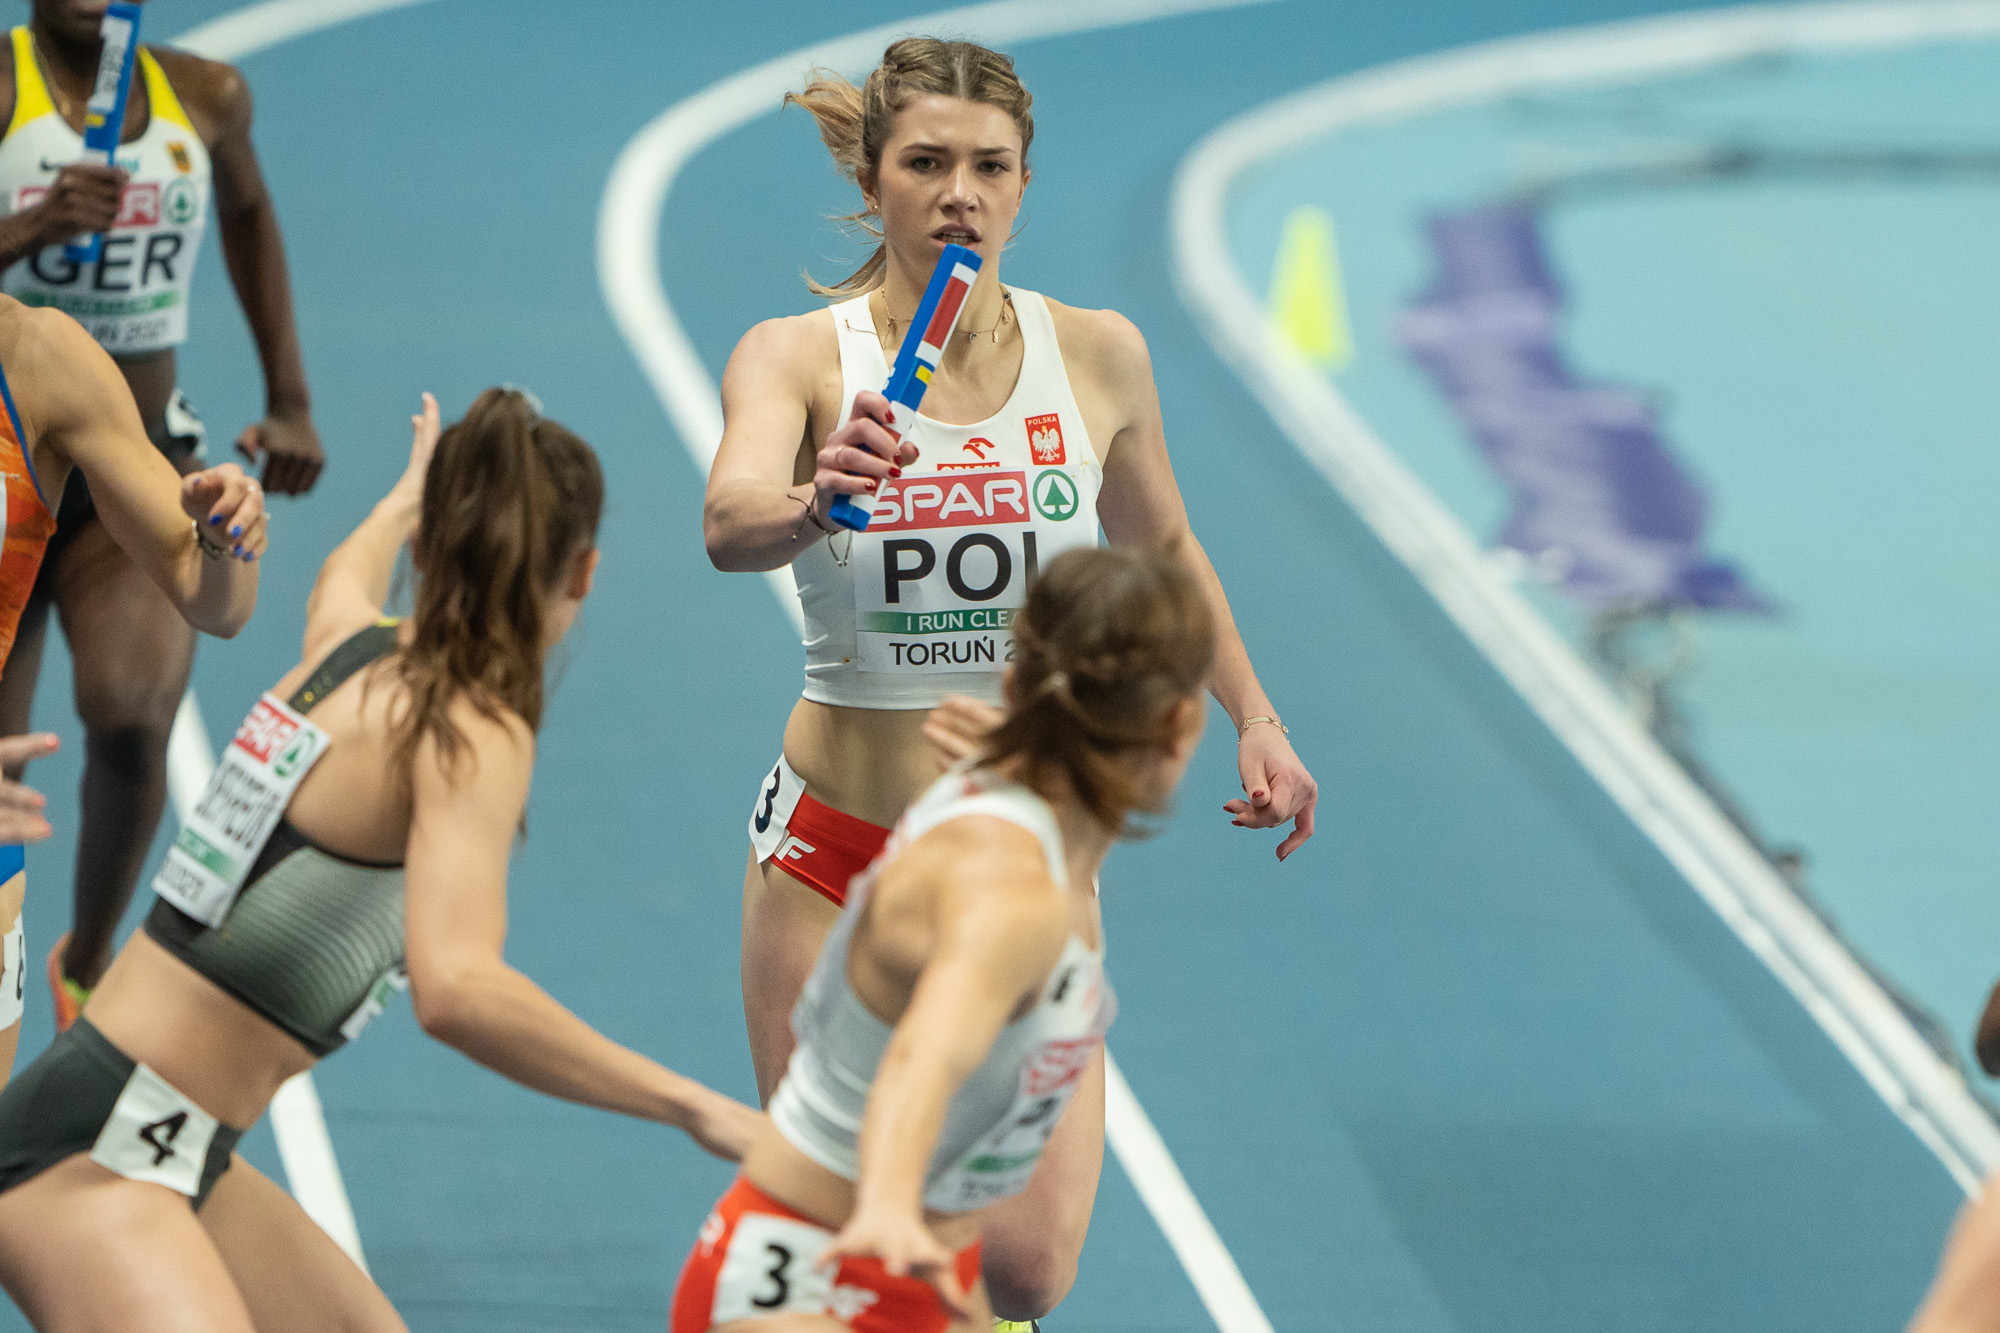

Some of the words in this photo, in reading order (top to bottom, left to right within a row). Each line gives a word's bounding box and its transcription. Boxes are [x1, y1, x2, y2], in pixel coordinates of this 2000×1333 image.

[30, 233, 182, 291] GER
[1027, 415, 1057, 427] POLSKA
[867, 478, 1025, 525] SPAR
[907, 616, 912, 631] I
[918, 613, 964, 631] RUN
[889, 635, 995, 665] TORUŃ
[755, 764, 781, 833] 3
[139, 1110, 190, 1167] 4
[751, 1243, 791, 1309] 3
